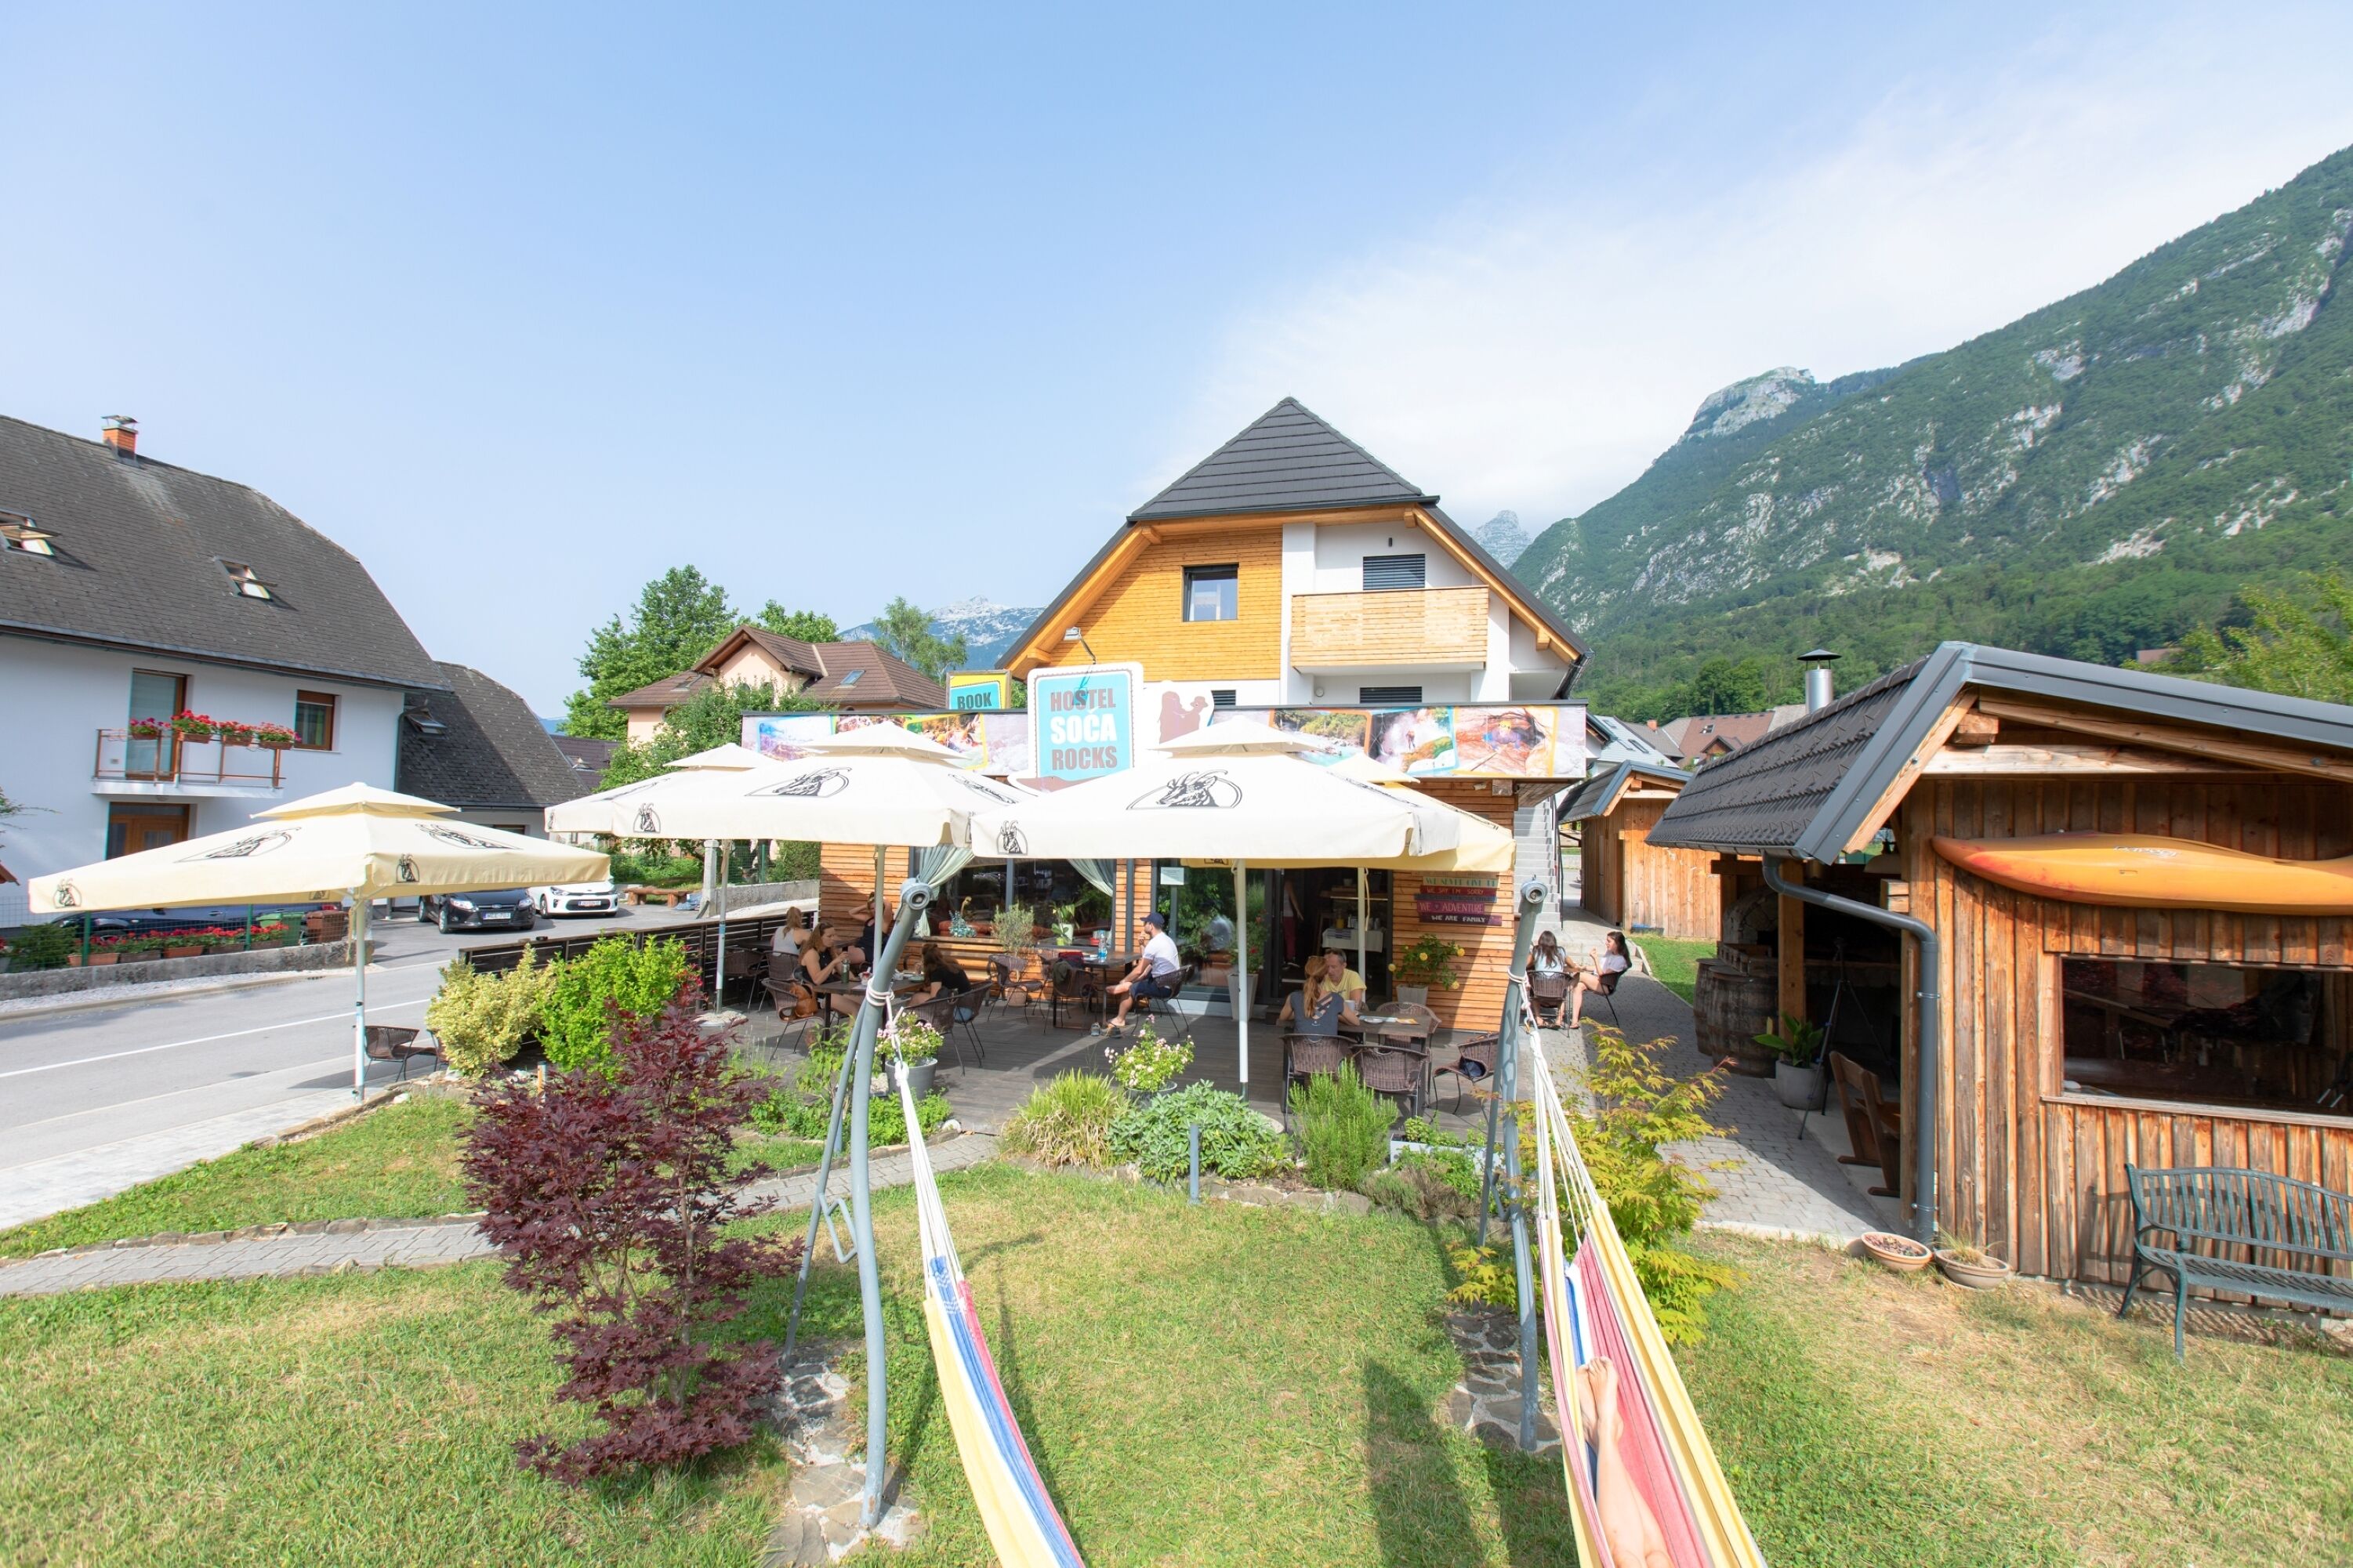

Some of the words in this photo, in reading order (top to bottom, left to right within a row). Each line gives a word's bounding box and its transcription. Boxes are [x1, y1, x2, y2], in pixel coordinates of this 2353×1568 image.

[957, 692, 992, 709] BOOK
[1050, 688, 1116, 712] HOSTEL
[1050, 707, 1117, 745] SOČA
[1052, 746, 1118, 771] ROCKS
[1419, 902, 1431, 911] WE
[1442, 903, 1484, 913] ADVENTURE
